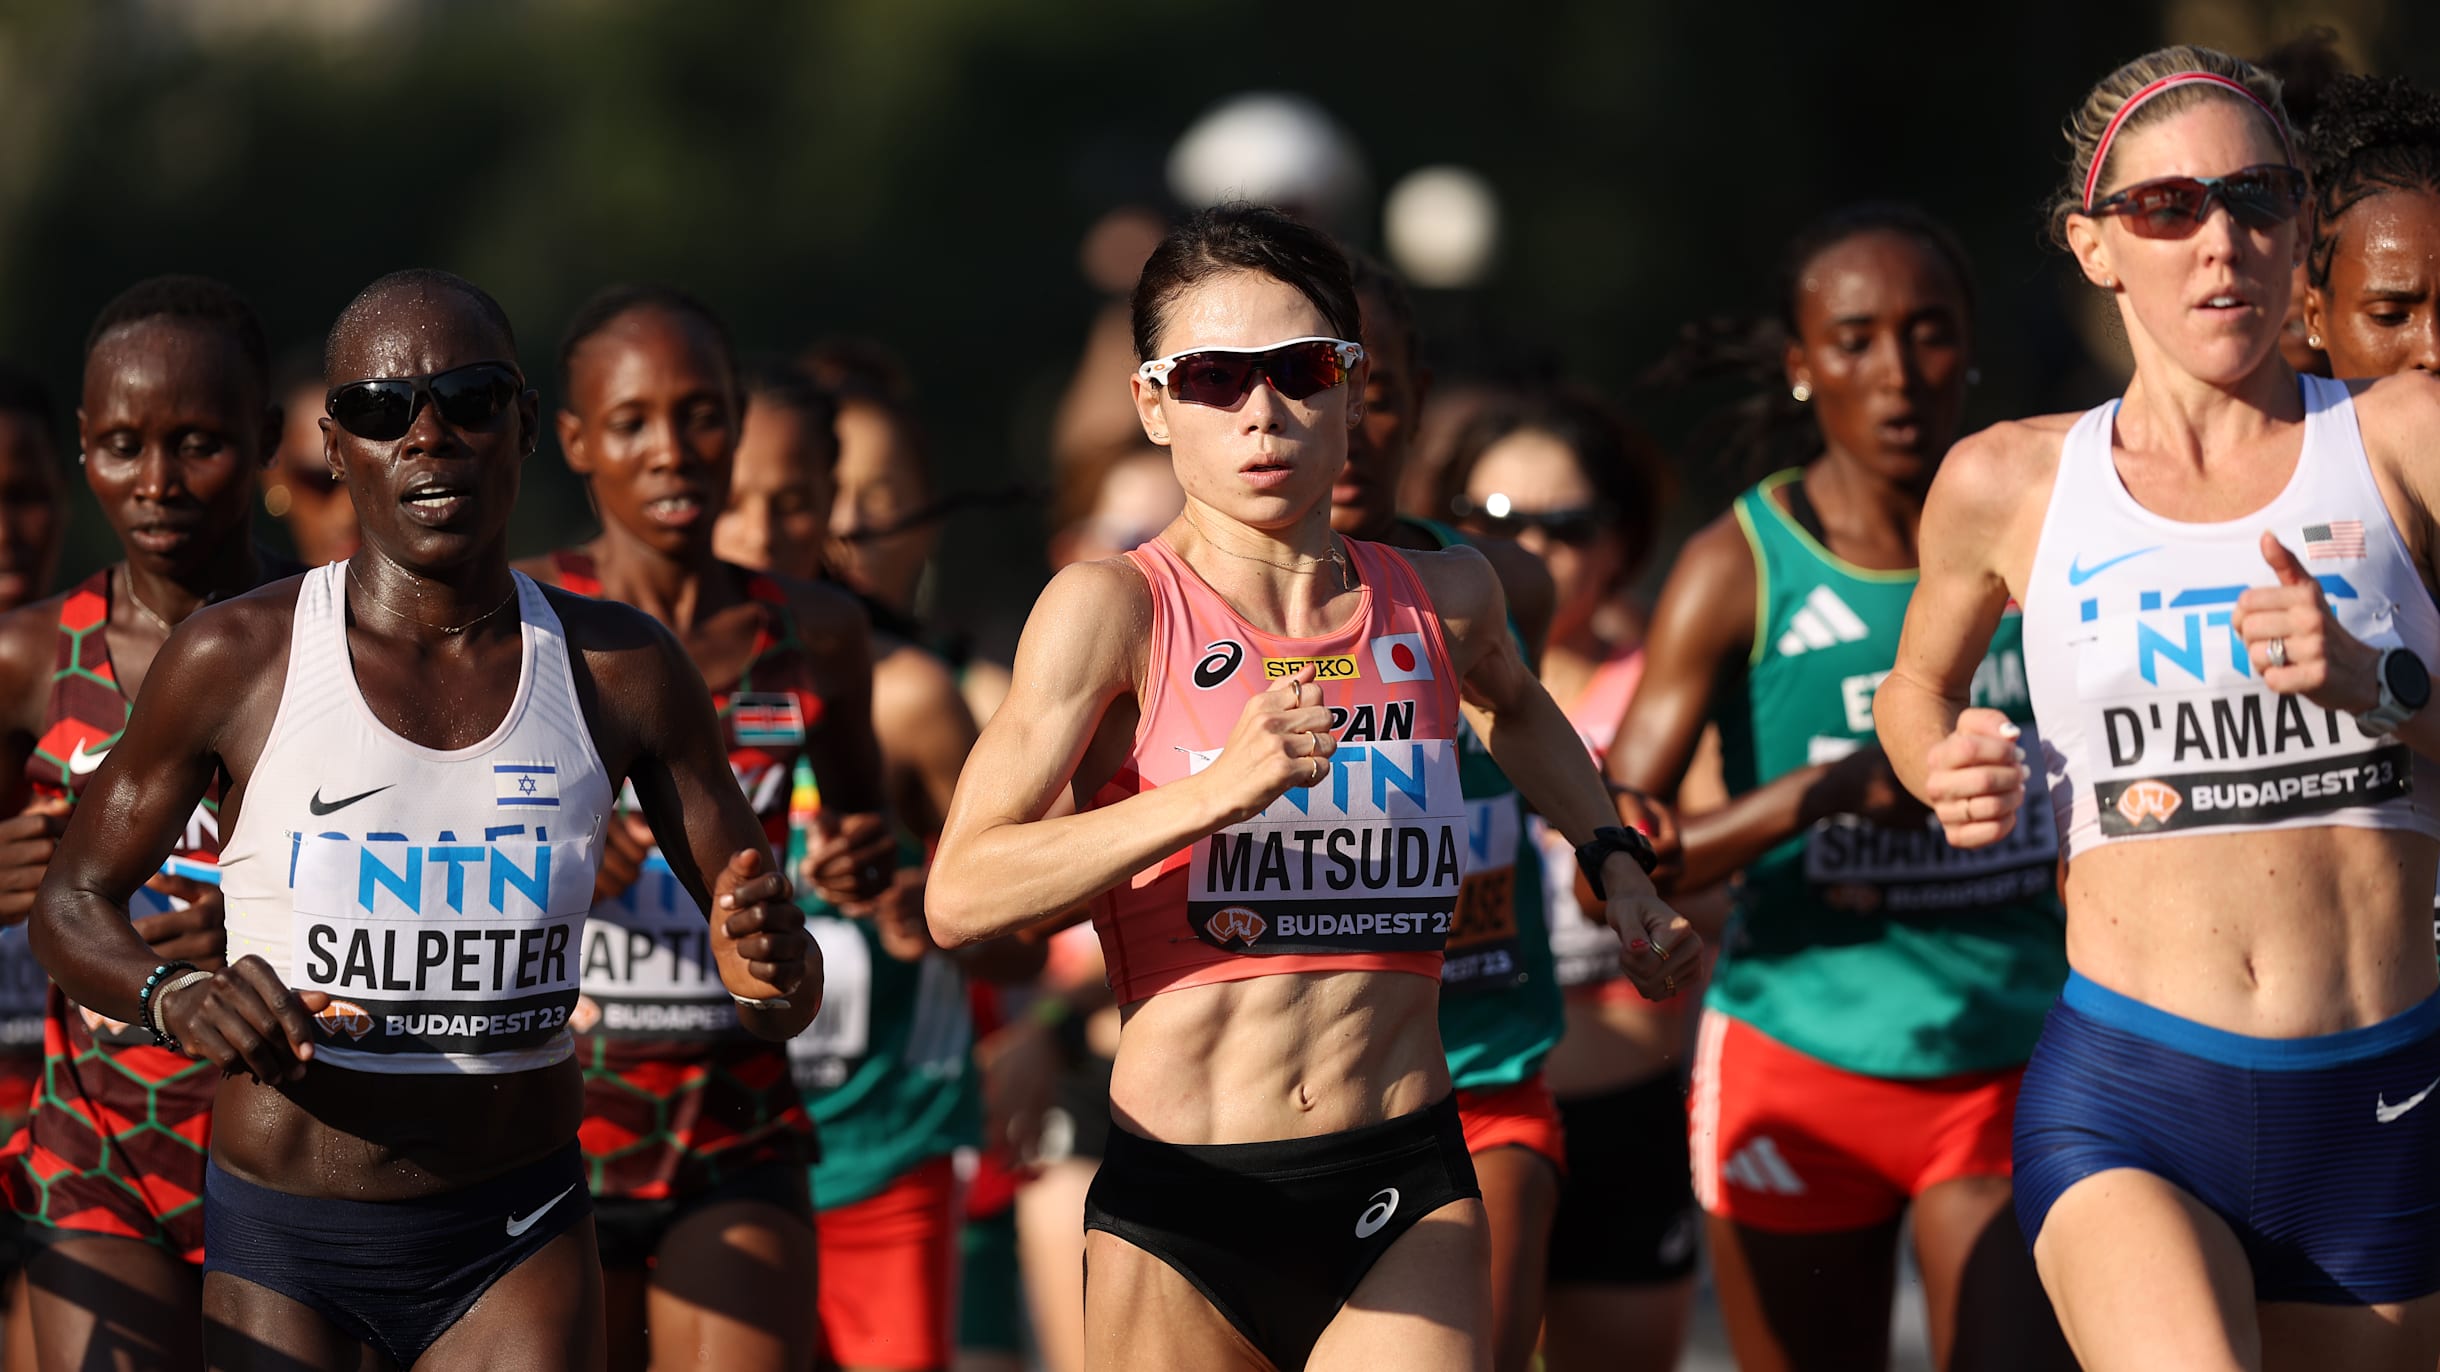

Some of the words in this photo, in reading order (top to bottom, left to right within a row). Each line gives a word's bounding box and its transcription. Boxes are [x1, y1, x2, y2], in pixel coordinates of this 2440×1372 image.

[1267, 658, 1354, 677] SEKO
[1328, 701, 1415, 741] PAN
[2191, 768, 2359, 811] BUDAPEST
[2365, 761, 2393, 787] 23
[358, 845, 551, 915] NTN
[1207, 825, 1459, 893] MATSUDA
[1277, 912, 1428, 937] BUDAPEST
[307, 924, 569, 991] SALPETER
[583, 928, 708, 982] APTI
[385, 1010, 536, 1037] BUDAPEST
[538, 1006, 566, 1029] 23
